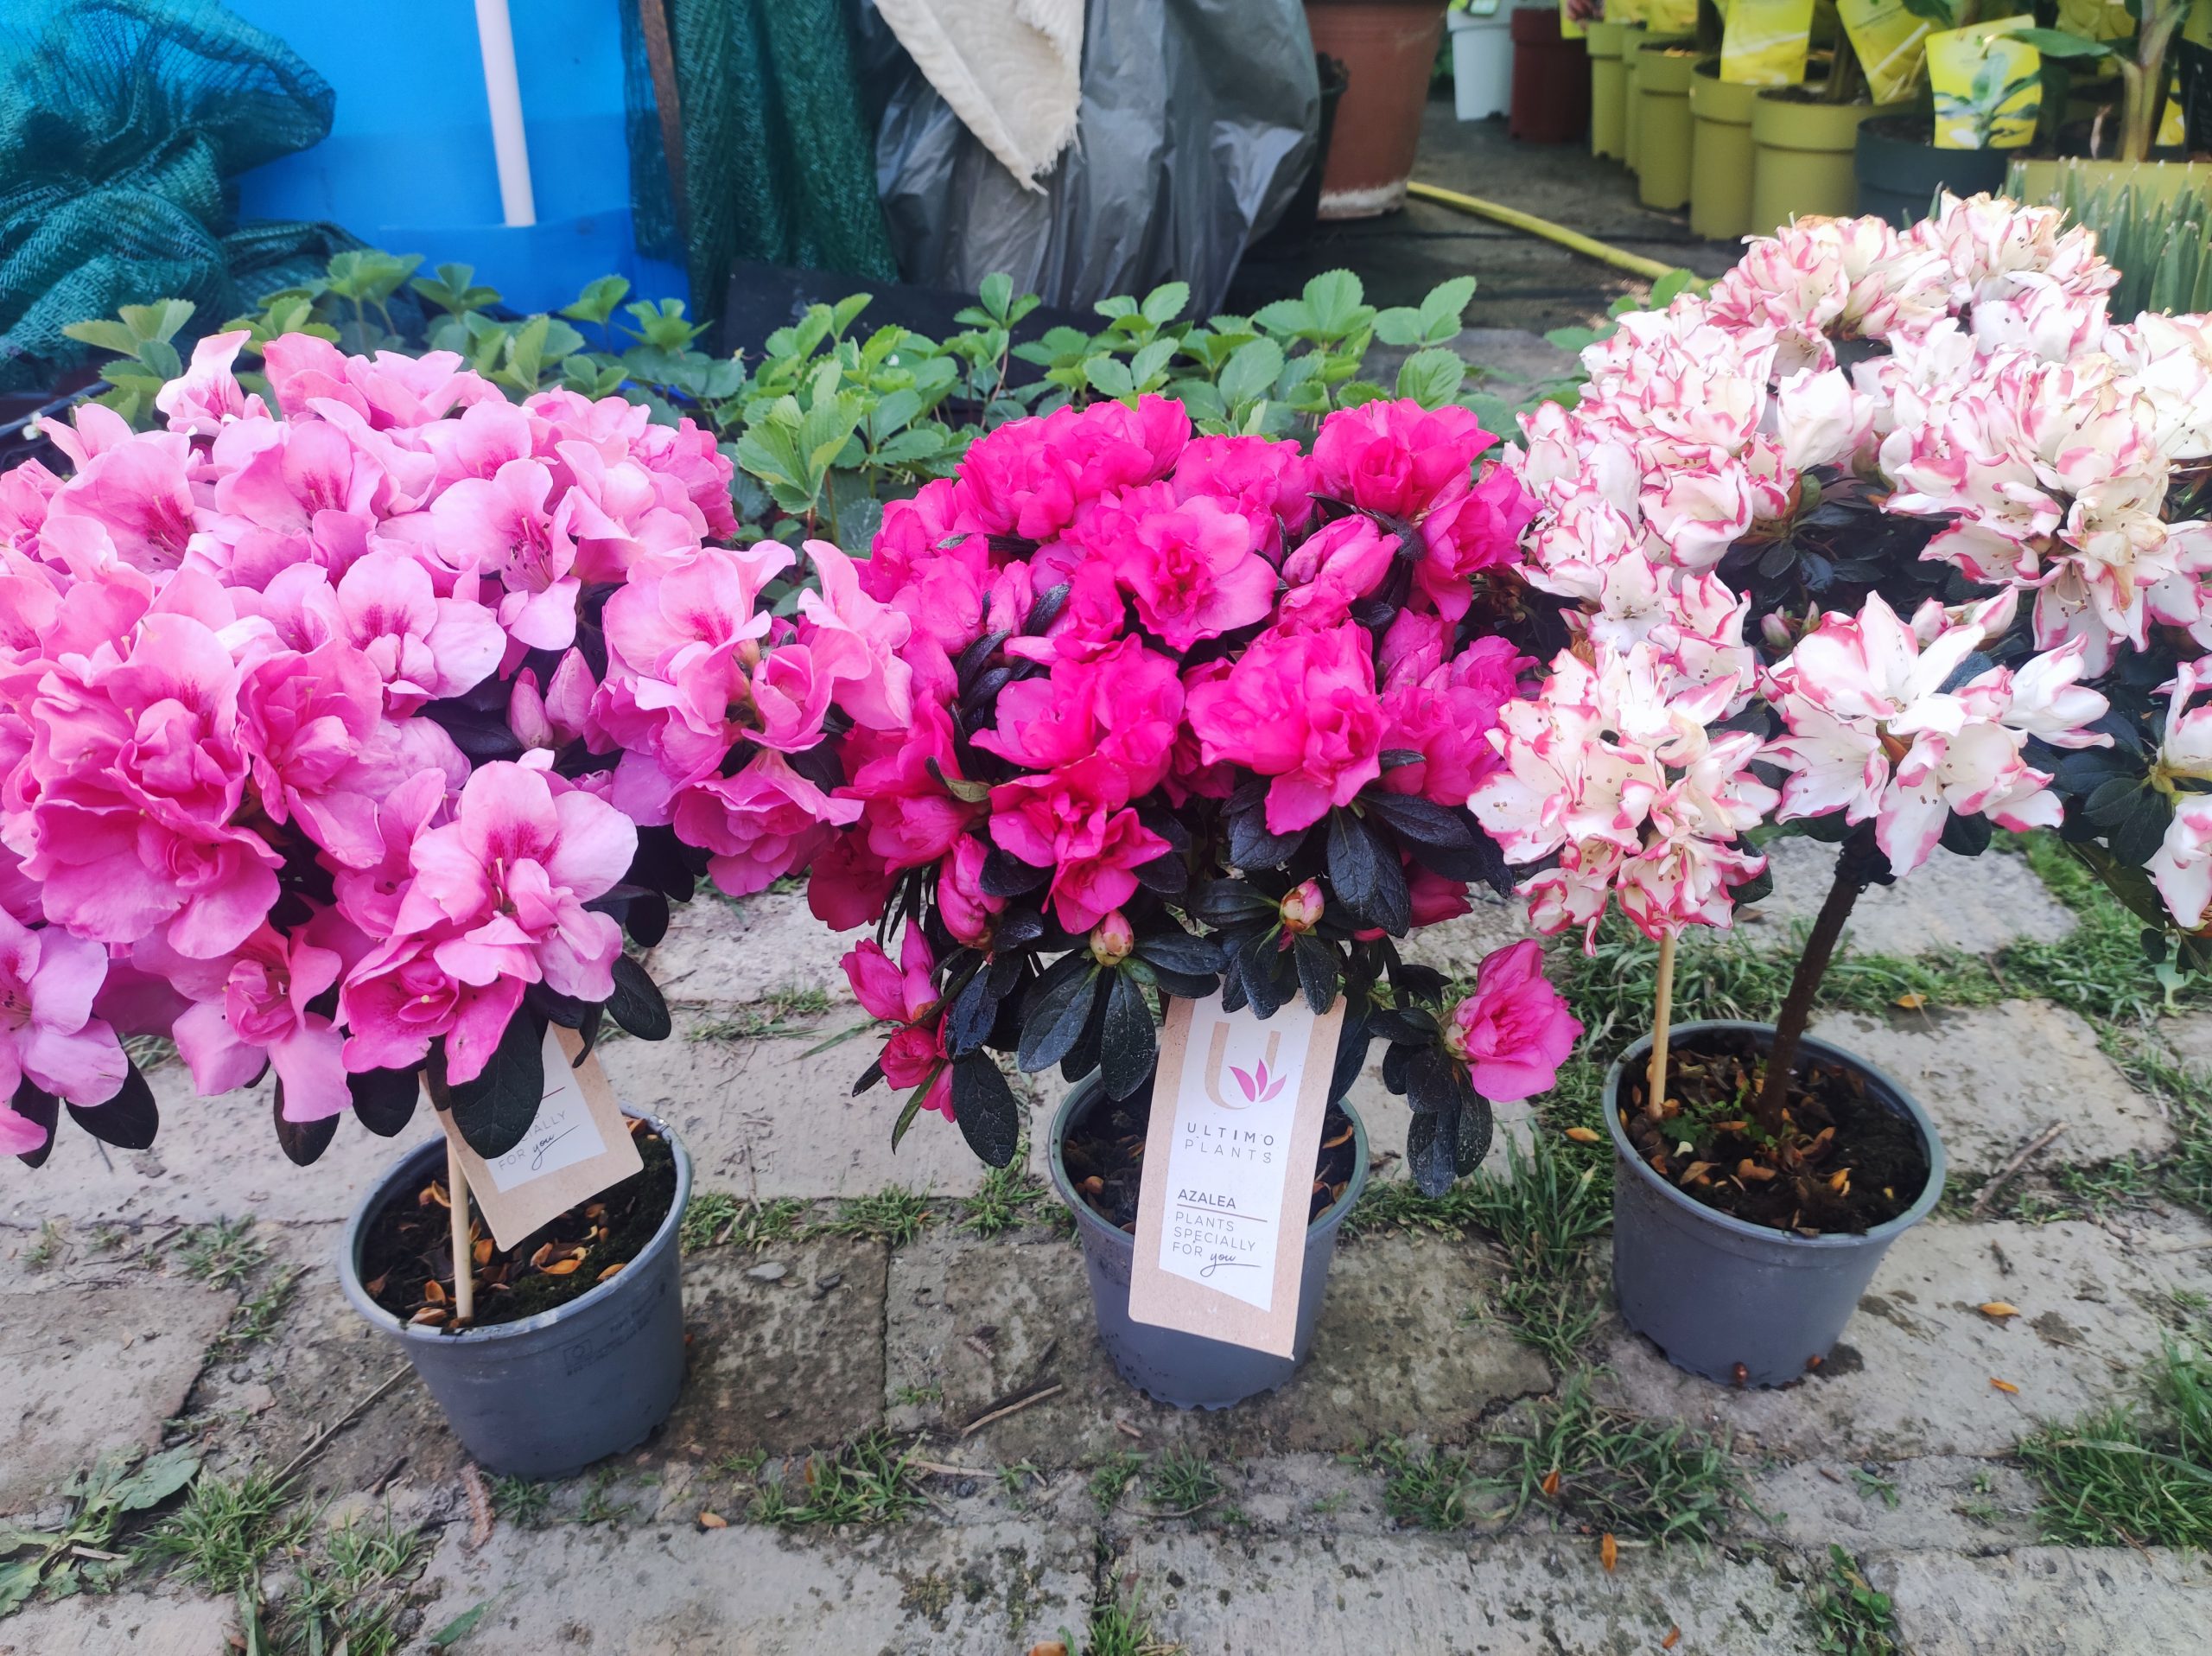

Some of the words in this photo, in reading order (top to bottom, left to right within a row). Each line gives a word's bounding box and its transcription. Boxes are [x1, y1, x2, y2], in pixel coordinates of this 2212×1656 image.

[522, 1110, 565, 1142] IALLY
[1186, 1122, 1274, 1146] ULTIMO
[499, 1149, 526, 1170] FOR
[1185, 1138, 1272, 1164] PLANTS
[1178, 1188, 1236, 1209] AZALEA
[1175, 1211, 1235, 1232] PLANTS
[1173, 1226, 1255, 1252] SPECIALLY
[1173, 1241, 1203, 1258] FOR
